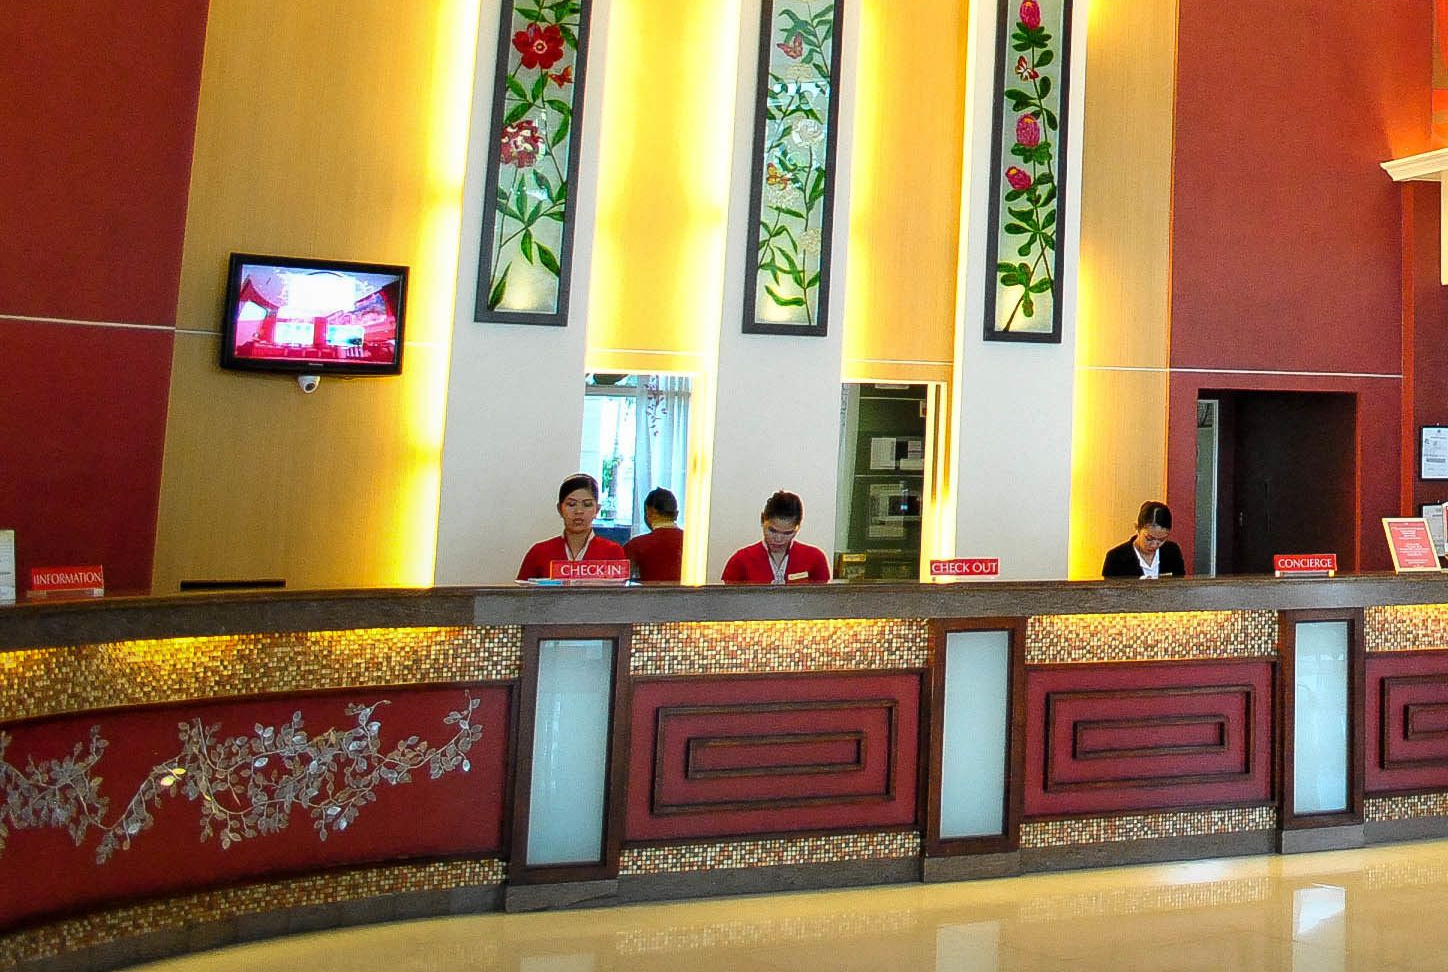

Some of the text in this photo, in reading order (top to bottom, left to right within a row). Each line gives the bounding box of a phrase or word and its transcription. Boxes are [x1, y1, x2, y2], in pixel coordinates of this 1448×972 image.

[931, 562, 997, 573] CHECK OUT
[1278, 558, 1332, 569] CONCIERGE
[560, 564, 621, 576] CHECK IN
[35, 571, 101, 585] INFORMATION
